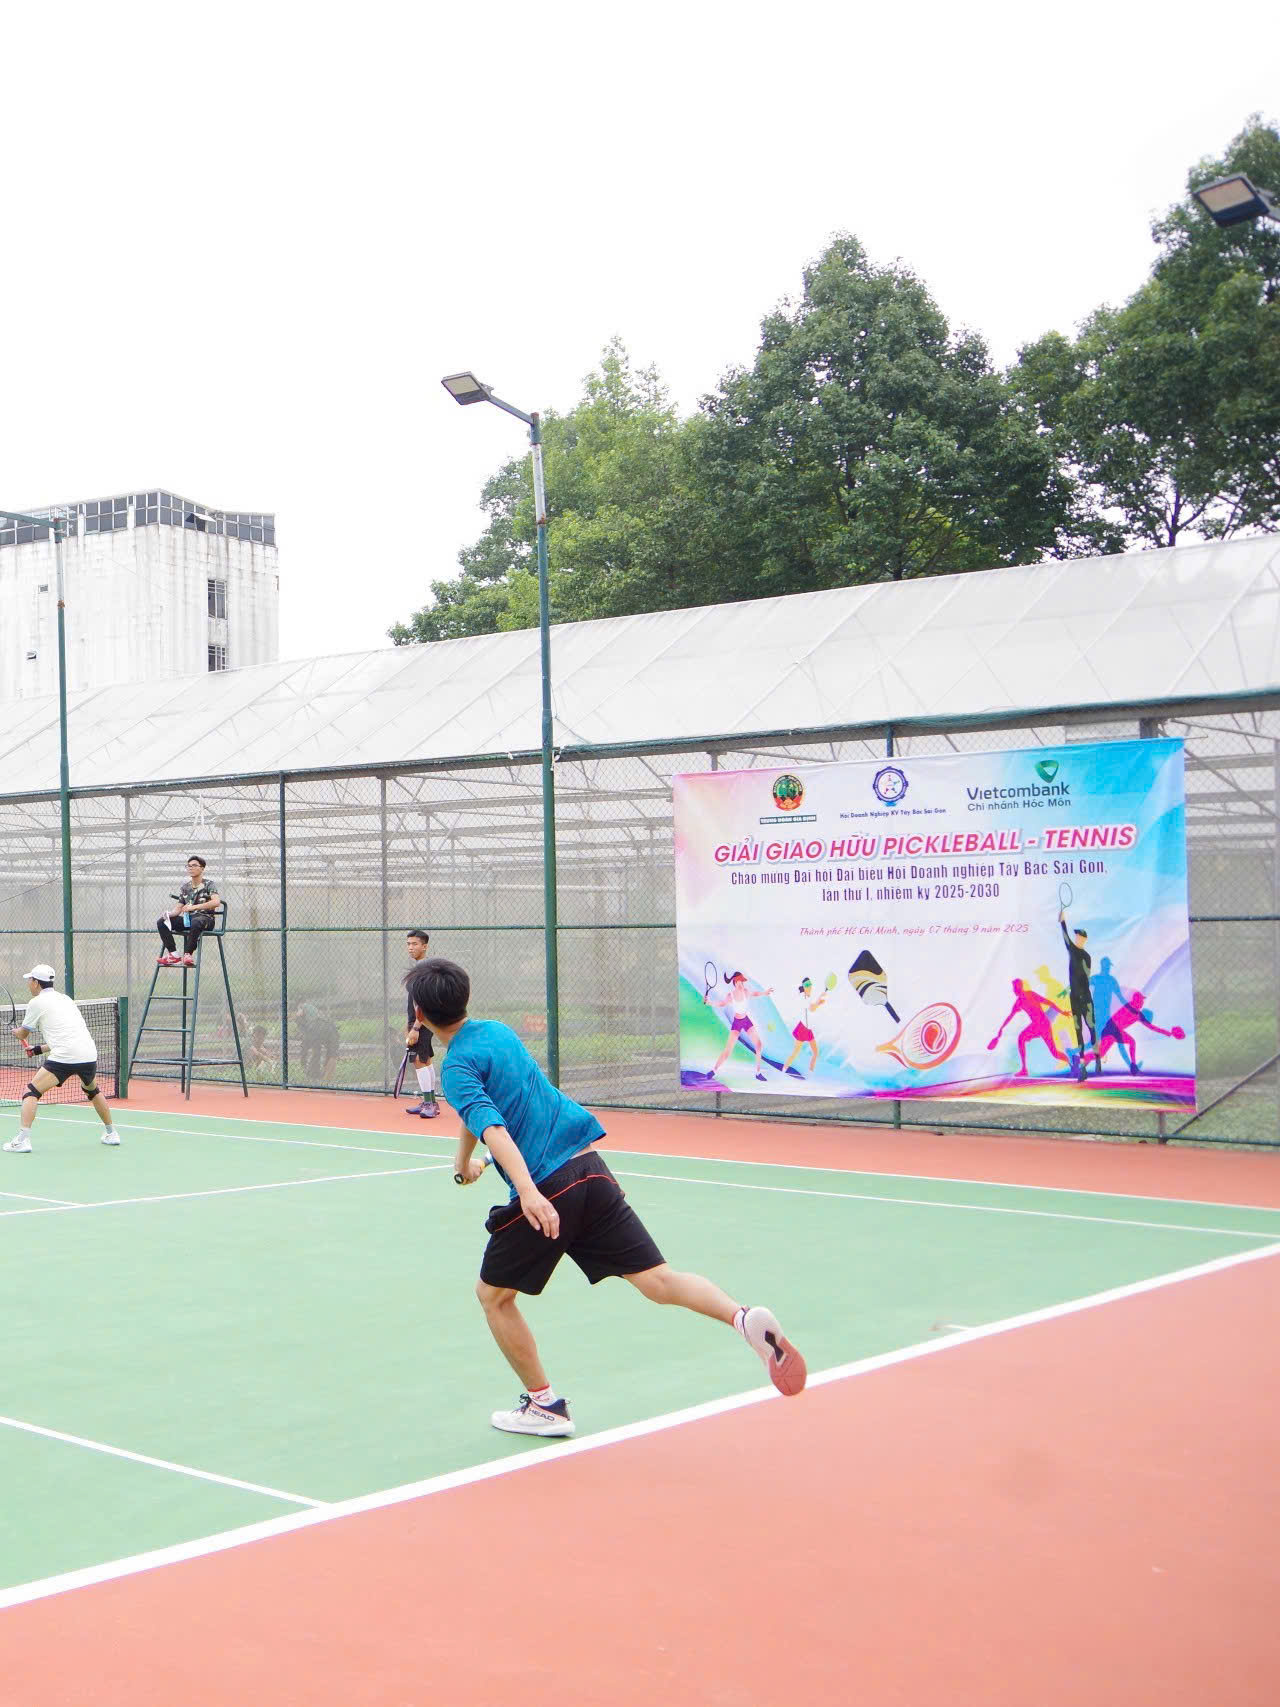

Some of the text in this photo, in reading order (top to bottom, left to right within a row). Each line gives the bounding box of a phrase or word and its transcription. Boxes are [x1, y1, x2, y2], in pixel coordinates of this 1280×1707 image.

[967, 781, 1070, 800] Vietcombank
[967, 797, 1071, 812] Chi nhánh Hóc Môn
[714, 837, 759, 863] GIẢI
[765, 840, 823, 861] GIAO
[829, 834, 876, 858] HỮU
[883, 831, 1019, 856] PICKLEBALL
[1045, 826, 1135, 849] TENNIS
[911, 864, 948, 879] Doanh
[935, 883, 1000, 899] 2025-2030
[1003, 923, 1029, 933] 2025
[528, 1407, 556, 1422] HEAD
